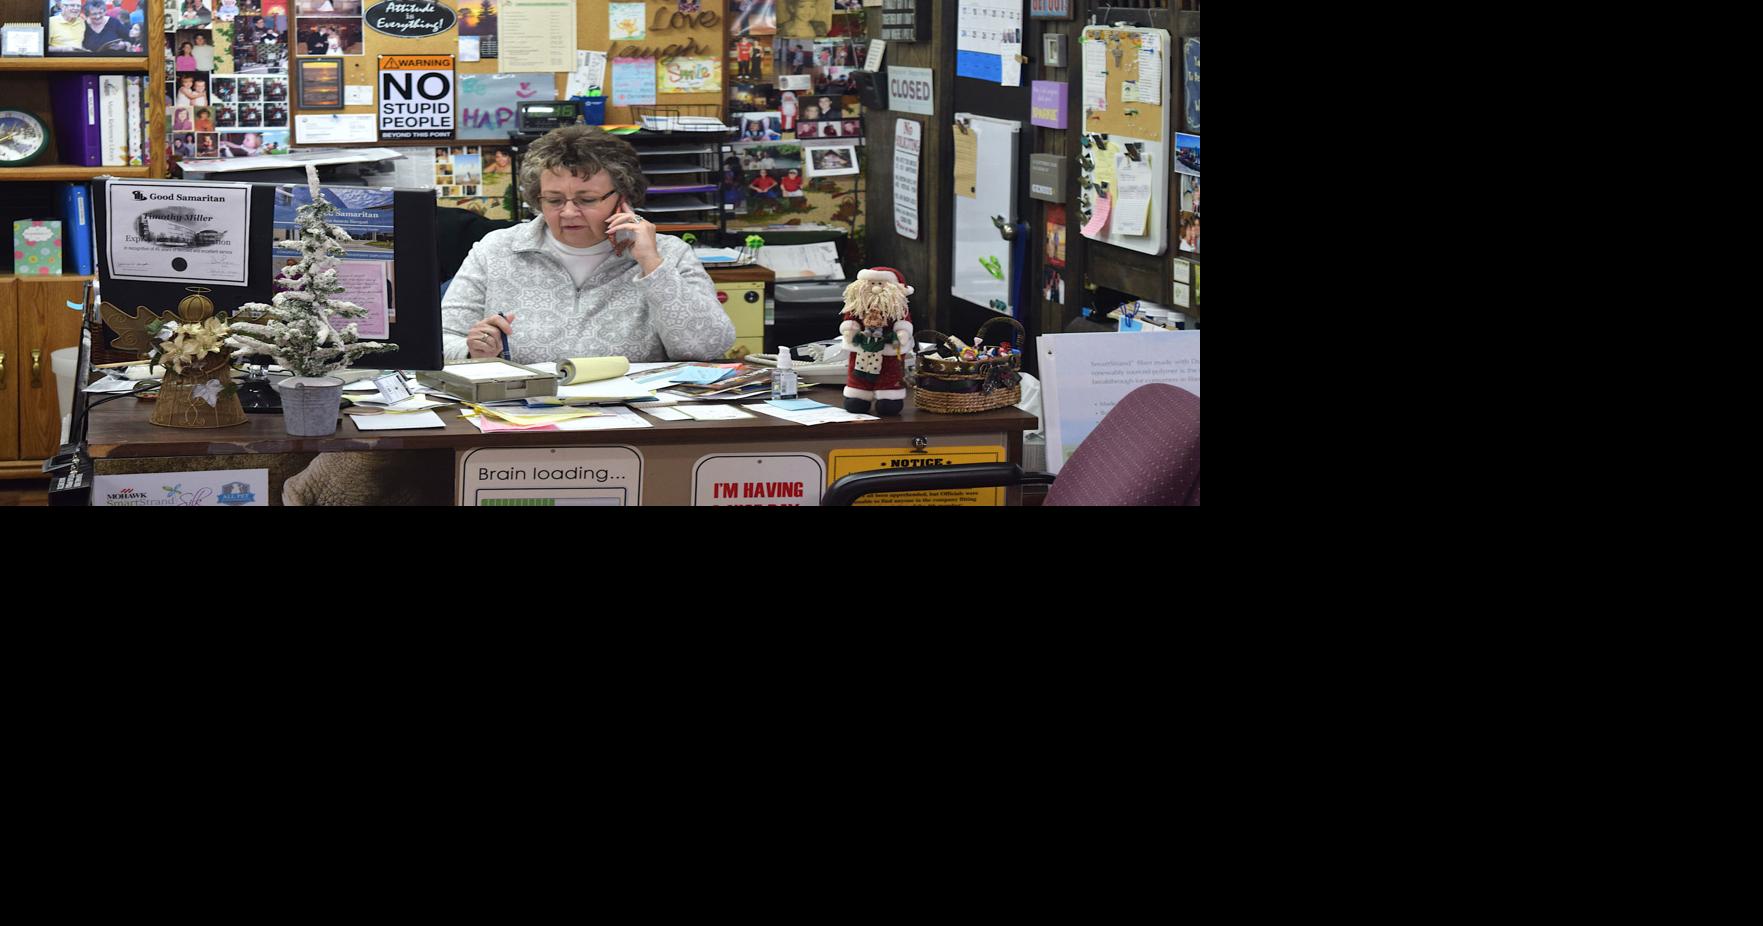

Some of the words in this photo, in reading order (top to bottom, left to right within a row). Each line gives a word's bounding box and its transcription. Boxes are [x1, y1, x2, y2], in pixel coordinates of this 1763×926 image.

[385, 2, 435, 13] Attitude
[376, 17, 444, 32] Everything!
[648, 6, 720, 32] Love
[399, 59, 450, 67] WARNING
[383, 72, 450, 100] NO
[891, 78, 930, 101] CLOSED
[383, 103, 450, 114] STUPID
[382, 117, 451, 128] PEOPLE
[150, 193, 174, 201] Good
[176, 193, 225, 203] Samaritan
[143, 212, 183, 222] Timothy
[185, 214, 214, 222] Miller
[336, 210, 379, 218] Samaritan
[890, 458, 943, 467] NOTICE
[479, 467, 526, 480] Brain
[533, 466, 625, 483] loading...
[713, 482, 738, 498] I'M
[743, 482, 803, 498] HAVING
